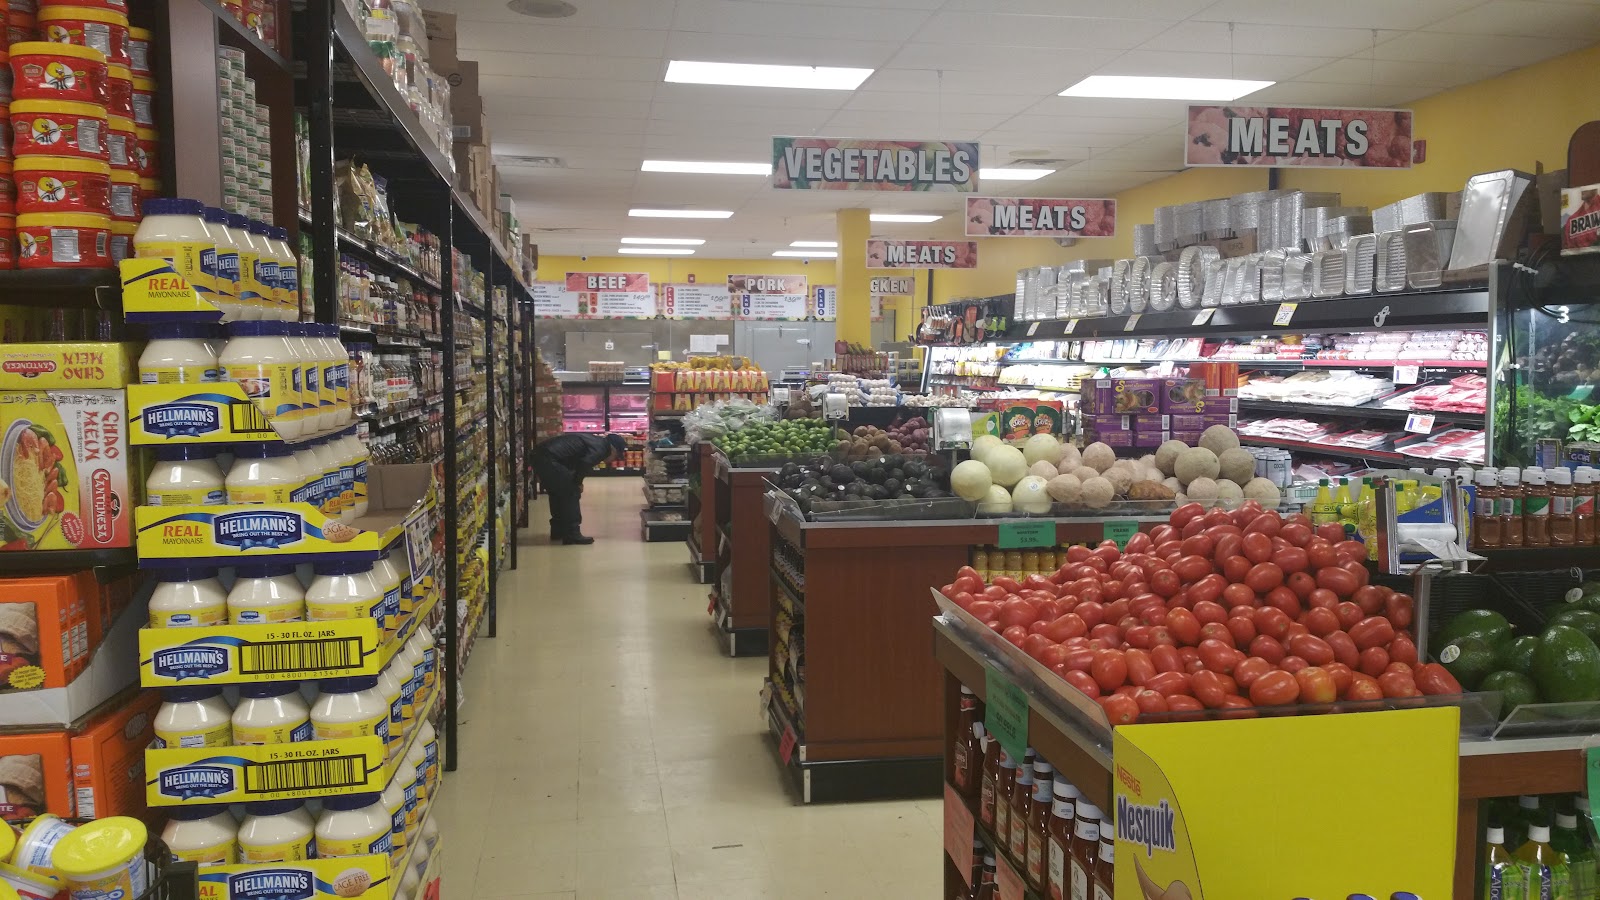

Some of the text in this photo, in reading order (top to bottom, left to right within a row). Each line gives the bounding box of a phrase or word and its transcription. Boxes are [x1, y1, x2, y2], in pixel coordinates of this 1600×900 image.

[1229, 117, 1369, 157] MEATS
[784, 146, 970, 183] VEGETABLES
[992, 204, 1087, 231] MEATS
[887, 245, 956, 264] MEATS
[149, 278, 191, 291] REAL
[587, 275, 627, 290] BEEF
[747, 278, 787, 292] PORK
[148, 290, 191, 299] MAYONNAISE
[6, 361, 55, 372] CANTONESA
[62, 353, 103, 365] MEIN
[62, 367, 104, 380] CHAO
[148, 408, 214, 425] HELLMANN'S
[83, 411, 100, 462] MEIN
[102, 411, 120, 460] CHAO
[94, 472, 109, 539] CANTONESA
[163, 526, 203, 537] REAL
[220, 517, 296, 535] HELLMANN'S
[323, 526, 341, 536] CAGE
[335, 530, 354, 539] EGGS
[318, 630, 336, 638] JARS
[158, 650, 224, 668] HELLMANN'S
[322, 748, 339, 757] JARS
[164, 770, 229, 787] HELLMANN'S
[1117, 796, 1175, 857] Nesquik
[234, 872, 308, 893] HELLMANN'S
[334, 873, 369, 892] CAGE FREE
[345, 885, 362, 895] EGGS
